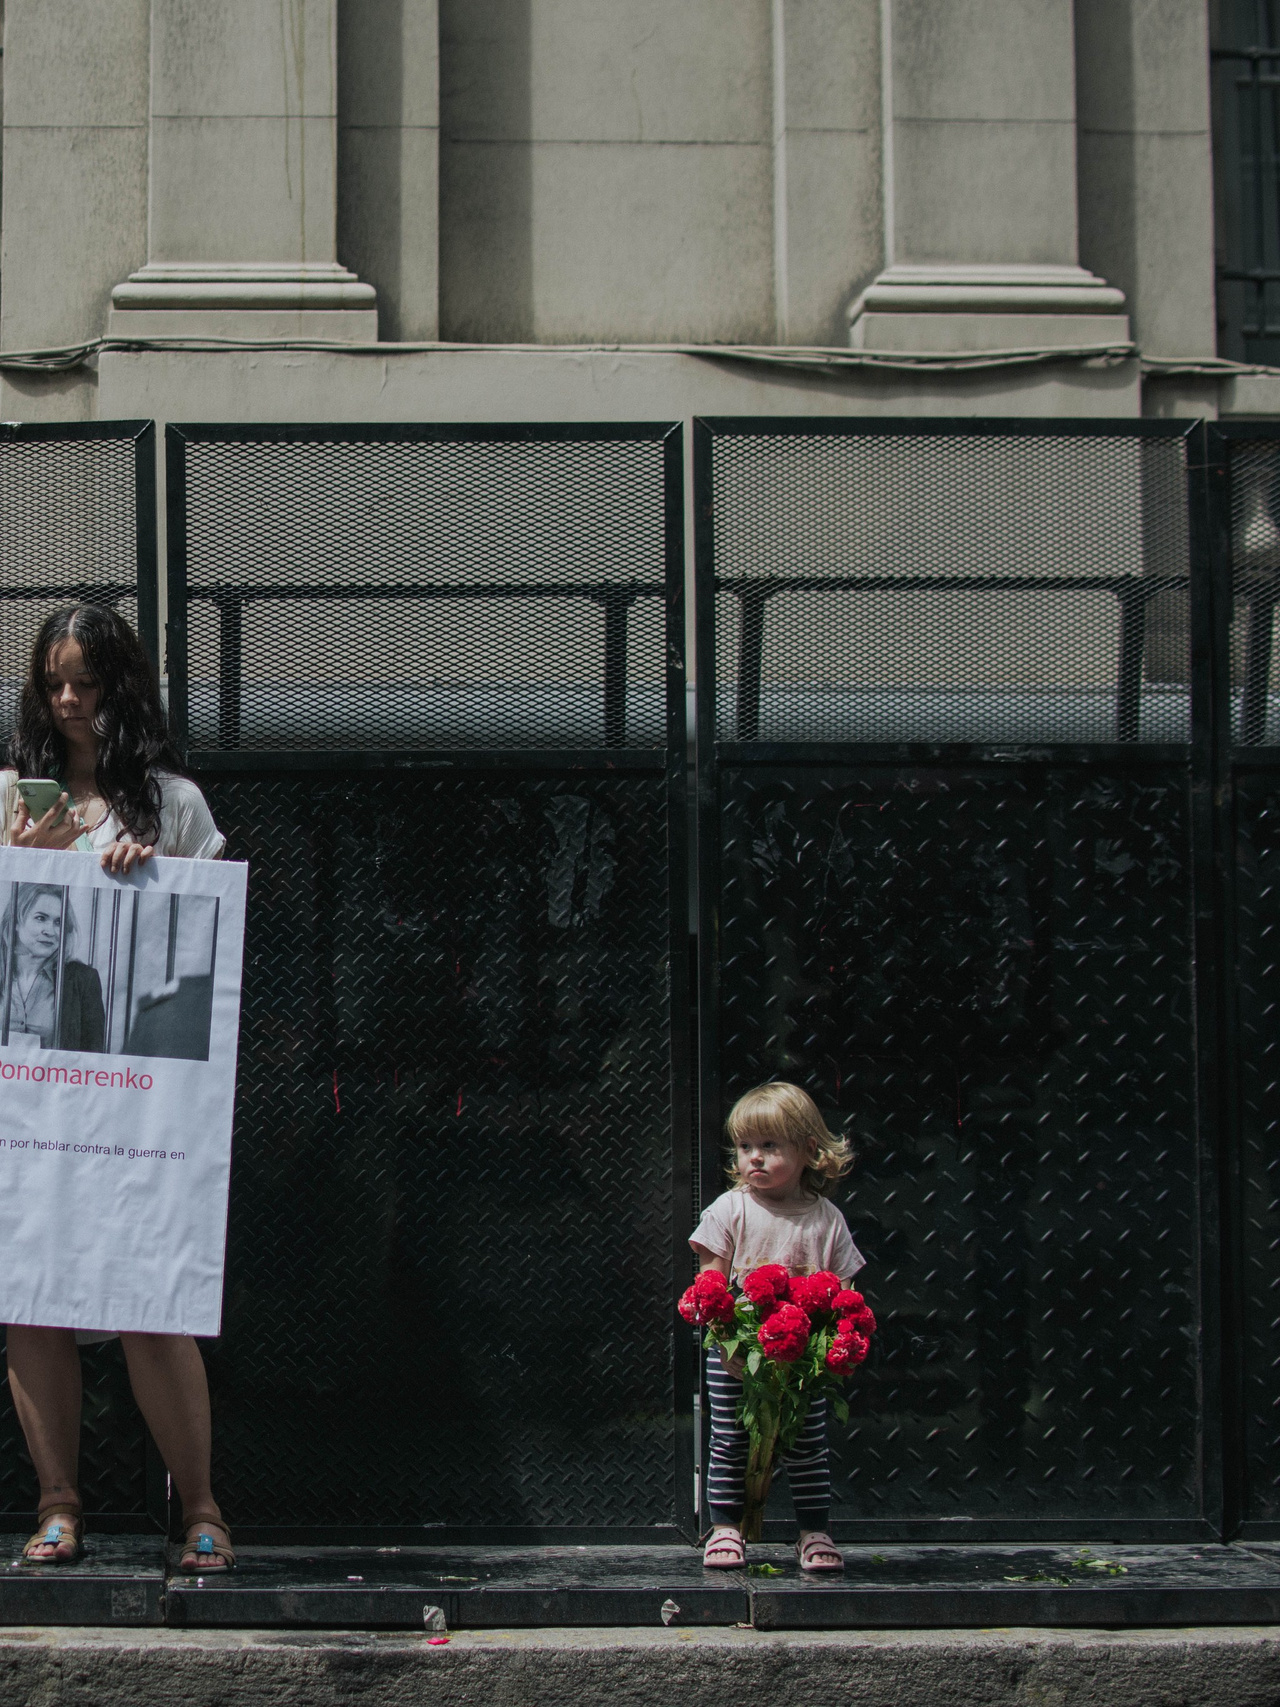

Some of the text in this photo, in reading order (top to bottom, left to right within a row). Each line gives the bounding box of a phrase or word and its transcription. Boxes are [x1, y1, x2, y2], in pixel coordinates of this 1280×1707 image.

[10, 1140, 30, 1149] por
[33, 1139, 70, 1151] hablar
[74, 1144, 110, 1155] contra
[114, 1145, 124, 1155] la
[128, 1148, 166, 1159] guerra
[171, 1152, 185, 1160] en
